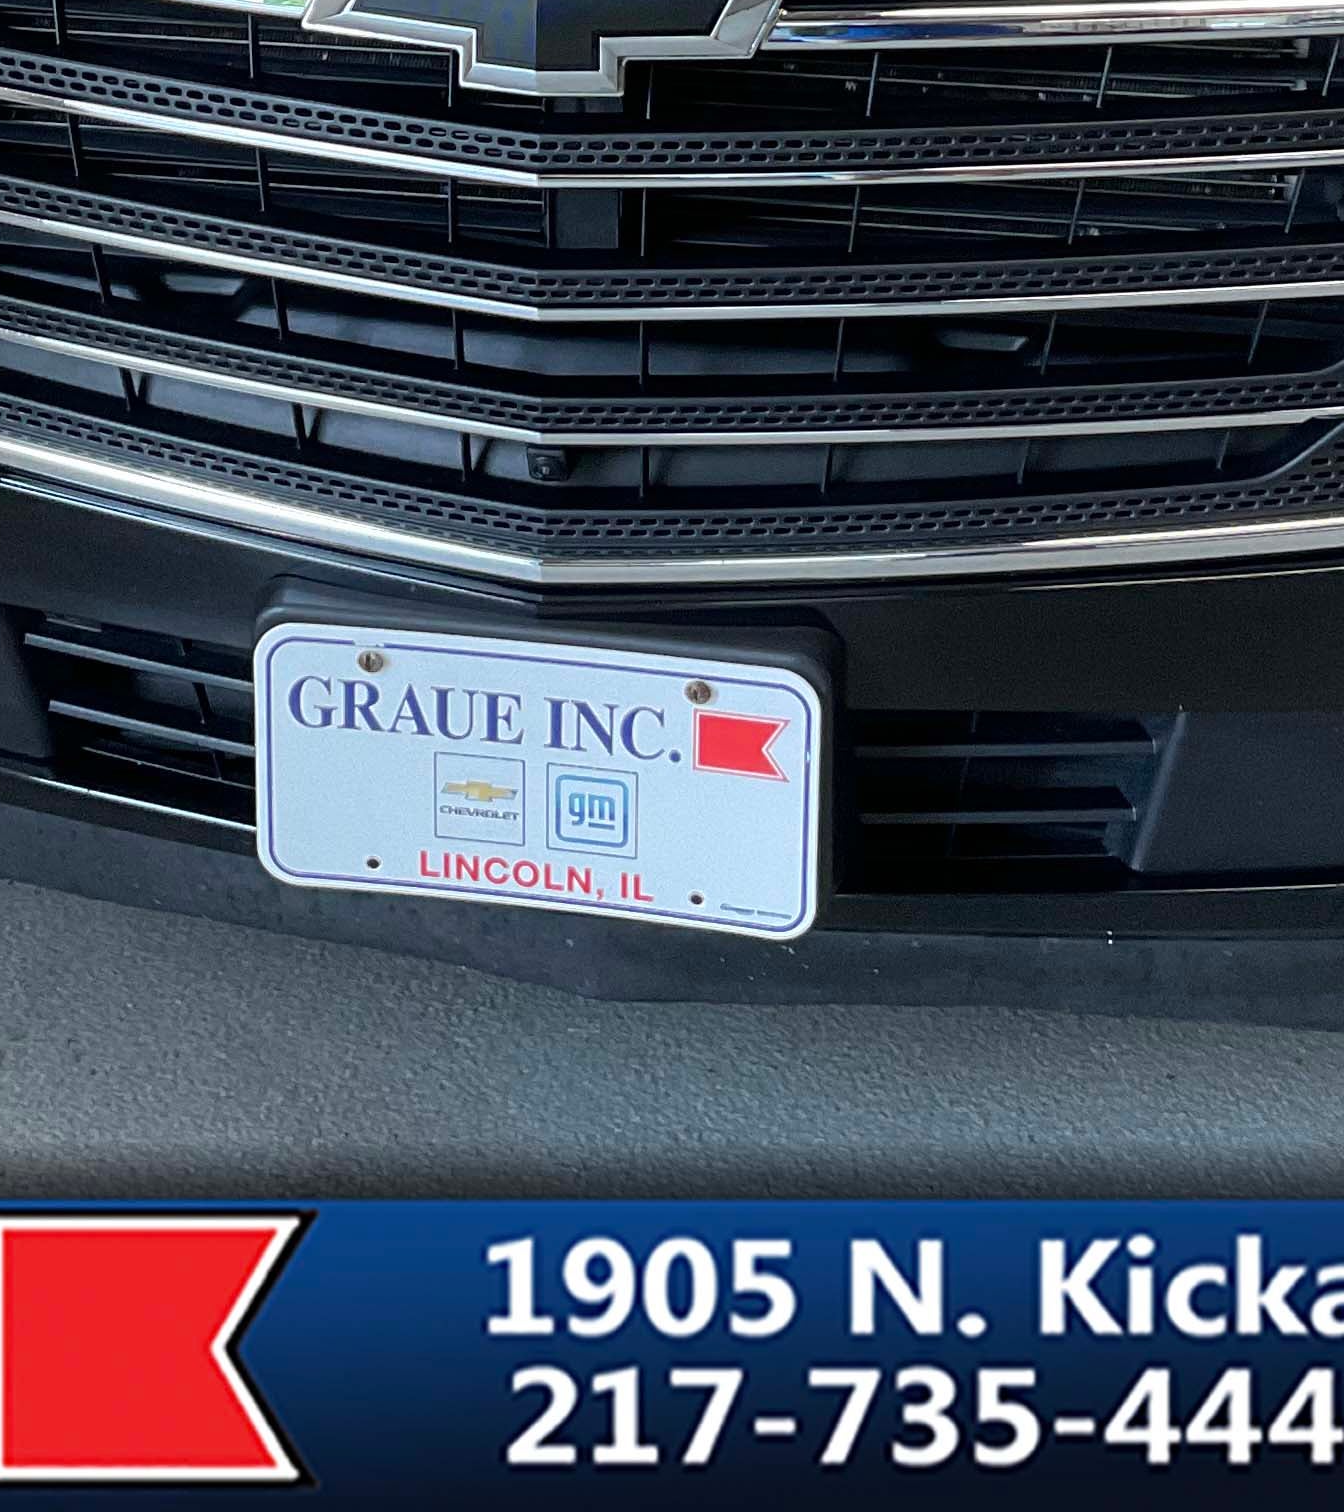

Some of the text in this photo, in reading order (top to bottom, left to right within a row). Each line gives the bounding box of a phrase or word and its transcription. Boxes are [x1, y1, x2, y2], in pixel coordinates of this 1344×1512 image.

[286, 674, 683, 764] GRAUE INC.
[438, 804, 520, 822] CHEVROLET
[567, 791, 616, 829] gm
[419, 849, 655, 903] LINCOLN, IL
